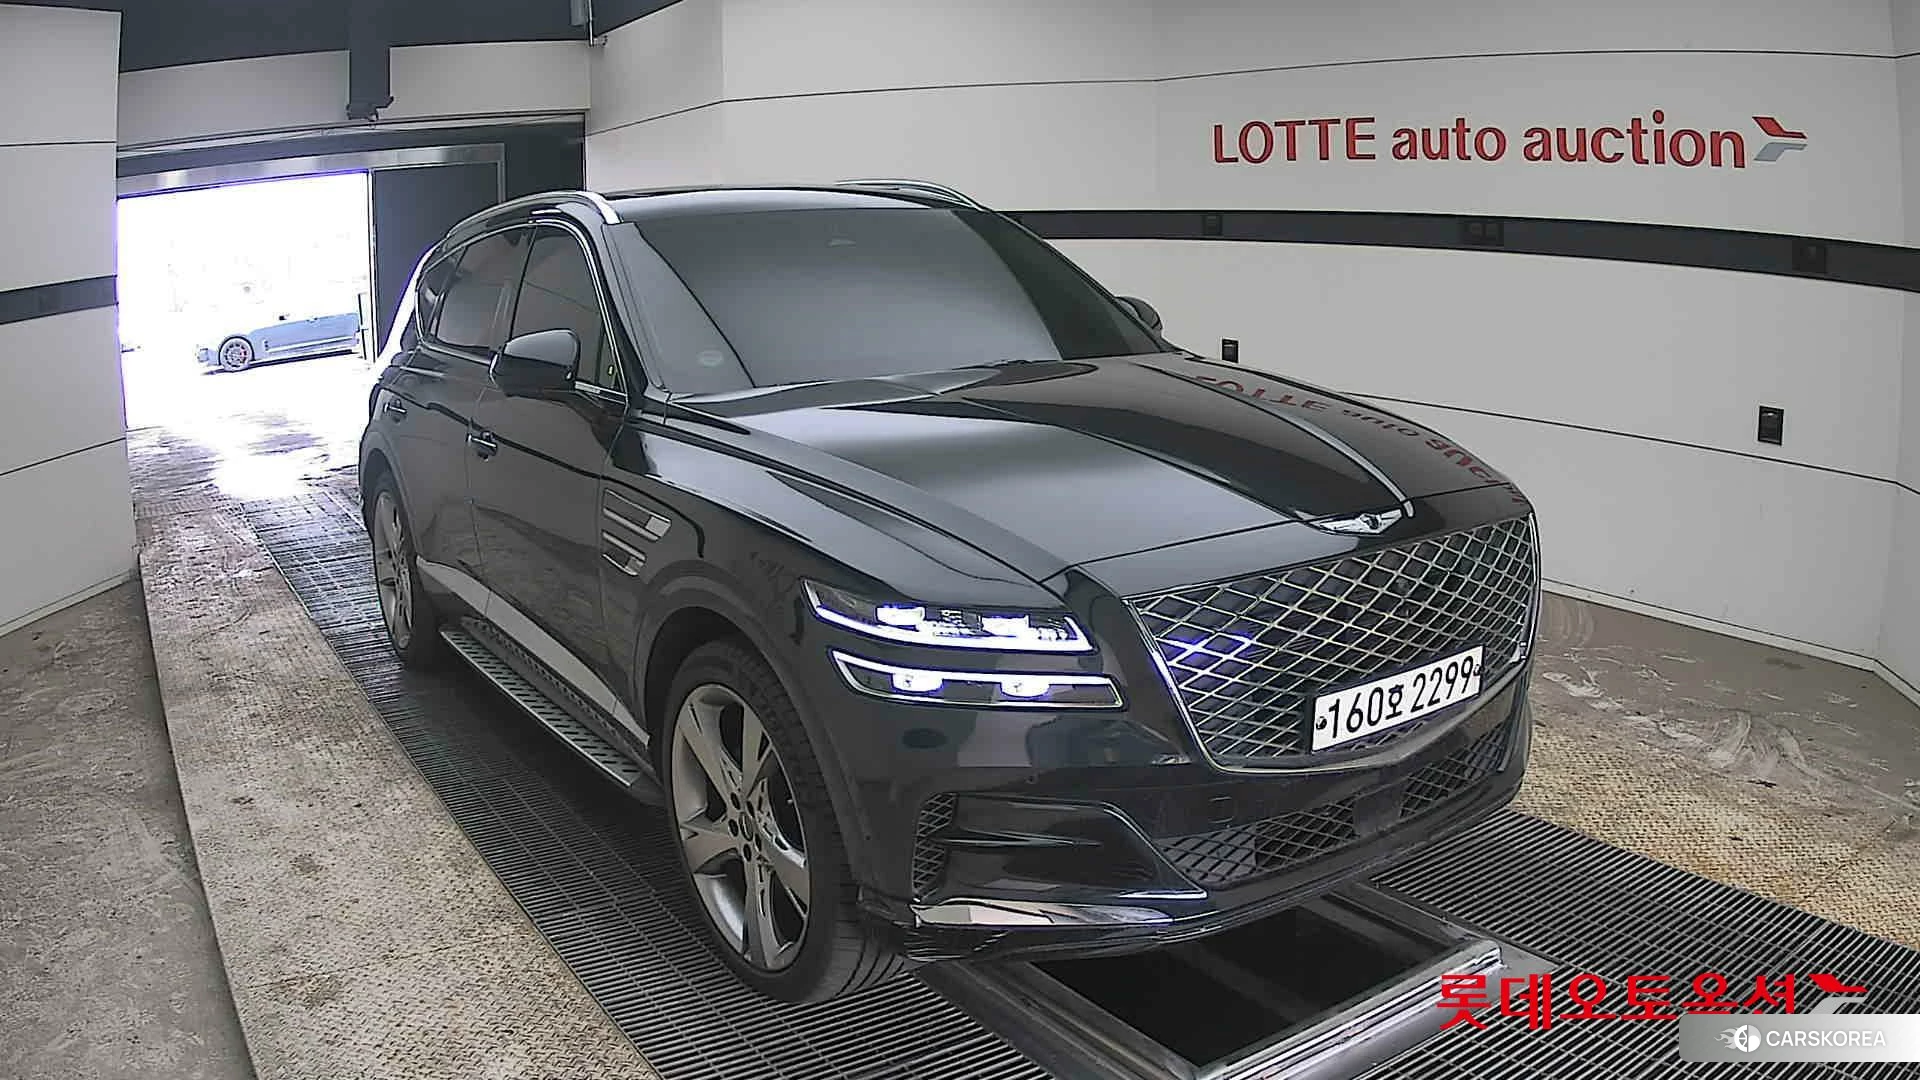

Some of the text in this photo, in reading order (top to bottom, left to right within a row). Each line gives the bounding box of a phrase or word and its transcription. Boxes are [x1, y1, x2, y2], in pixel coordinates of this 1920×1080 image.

[1213, 109, 1746, 169] LOTTE auto auction
[1410, 655, 1474, 713] 2299
